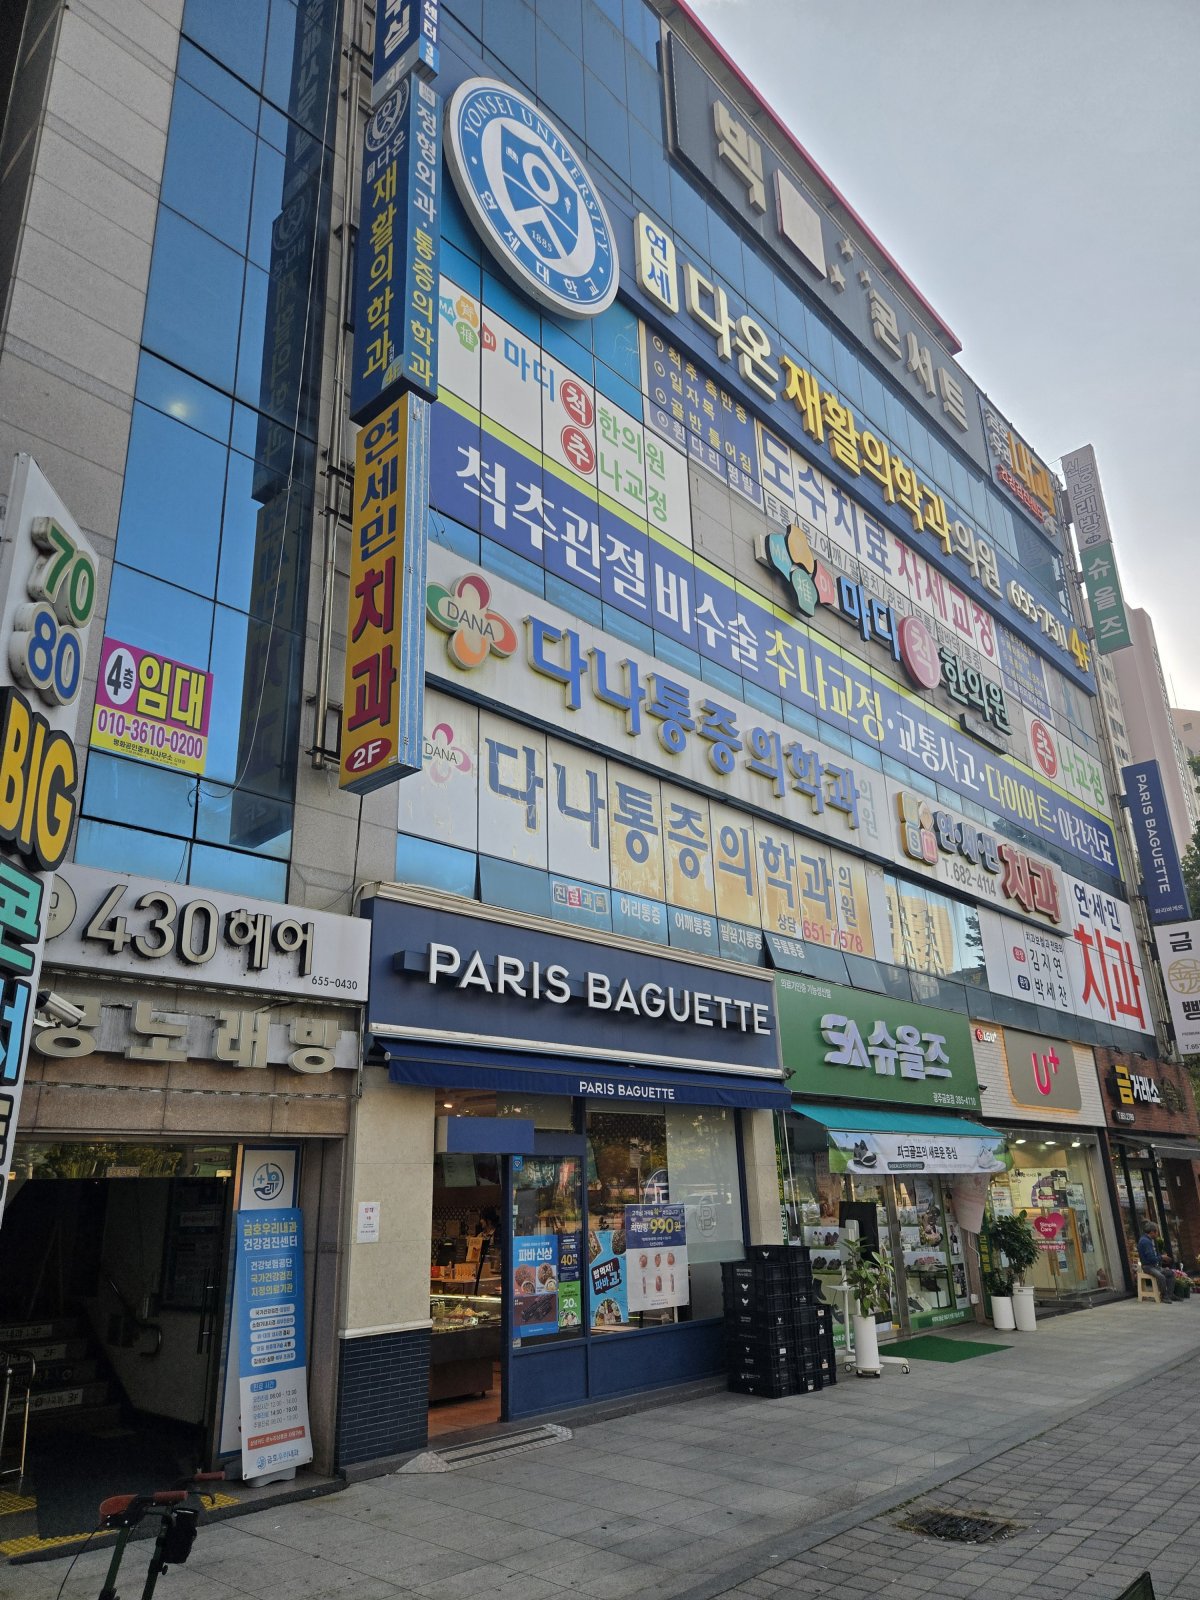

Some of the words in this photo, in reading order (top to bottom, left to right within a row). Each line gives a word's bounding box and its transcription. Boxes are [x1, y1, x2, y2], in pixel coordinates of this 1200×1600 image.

[464, 93, 515, 139] YONSEI
[521, 108, 609, 257] UNIVERSITY
[362, 160, 398, 380] 재활의학과
[530, 229, 554, 253] 1885
[503, 336, 555, 403] 마디
[868, 287, 969, 432] 콘서트
[645, 224, 672, 305] 연세
[682, 262, 780, 406] 다온
[779, 355, 953, 557] 재활의학과
[951, 520, 1004, 601] 의원
[1072, 482, 1101, 536] 노래방
[761, 426, 893, 577] 도수치료
[893, 537, 995, 659] 자세교정
[45, 526, 96, 624] 70
[347, 556, 397, 734] 치과
[446, 600, 496, 642] DANA
[27, 609, 81, 699] 80
[836, 575, 901, 662] 마디
[938, 645, 1014, 737] 한의원
[106, 654, 135, 697] 4층
[137, 655, 207, 730] 임대
[522, 614, 861, 831] 다나통증의학과
[97, 709, 204, 760] 010-3610-0200
[352, 738, 384, 771] 2F
[425, 742, 459, 765] DANA
[0, 695, 77, 864] BIG
[1136, 773, 1154, 816] PARIS
[485, 737, 834, 922] 다나통증의학과
[1144, 818, 1172, 895] BAGUETTE
[619, 899, 662, 925] 허리통증
[997, 843, 1061, 924] 치과
[674, 912, 713, 938] 어깨통증
[802, 919, 864, 954] 651-7578
[1169, 930, 1193, 953] 금
[311, 975, 359, 991] 655-0430
[427, 942, 571, 1005] PARIS
[586, 970, 772, 1036] BAGUETTE
[1072, 922, 1147, 1031] 치과
[867, 1020, 953, 1080] 슈올즈
[579, 1081, 616, 1097] PARIS
[618, 1083, 676, 1100] BAGUETTE
[897, 1144, 928, 1160] 파크골프의
[243, 1221, 298, 1236] 금호우리내과
[243, 1235, 298, 1251] 건강검진센터
[518, 1248, 536, 1262] 파바
[536, 1247, 553, 1261] 신상
